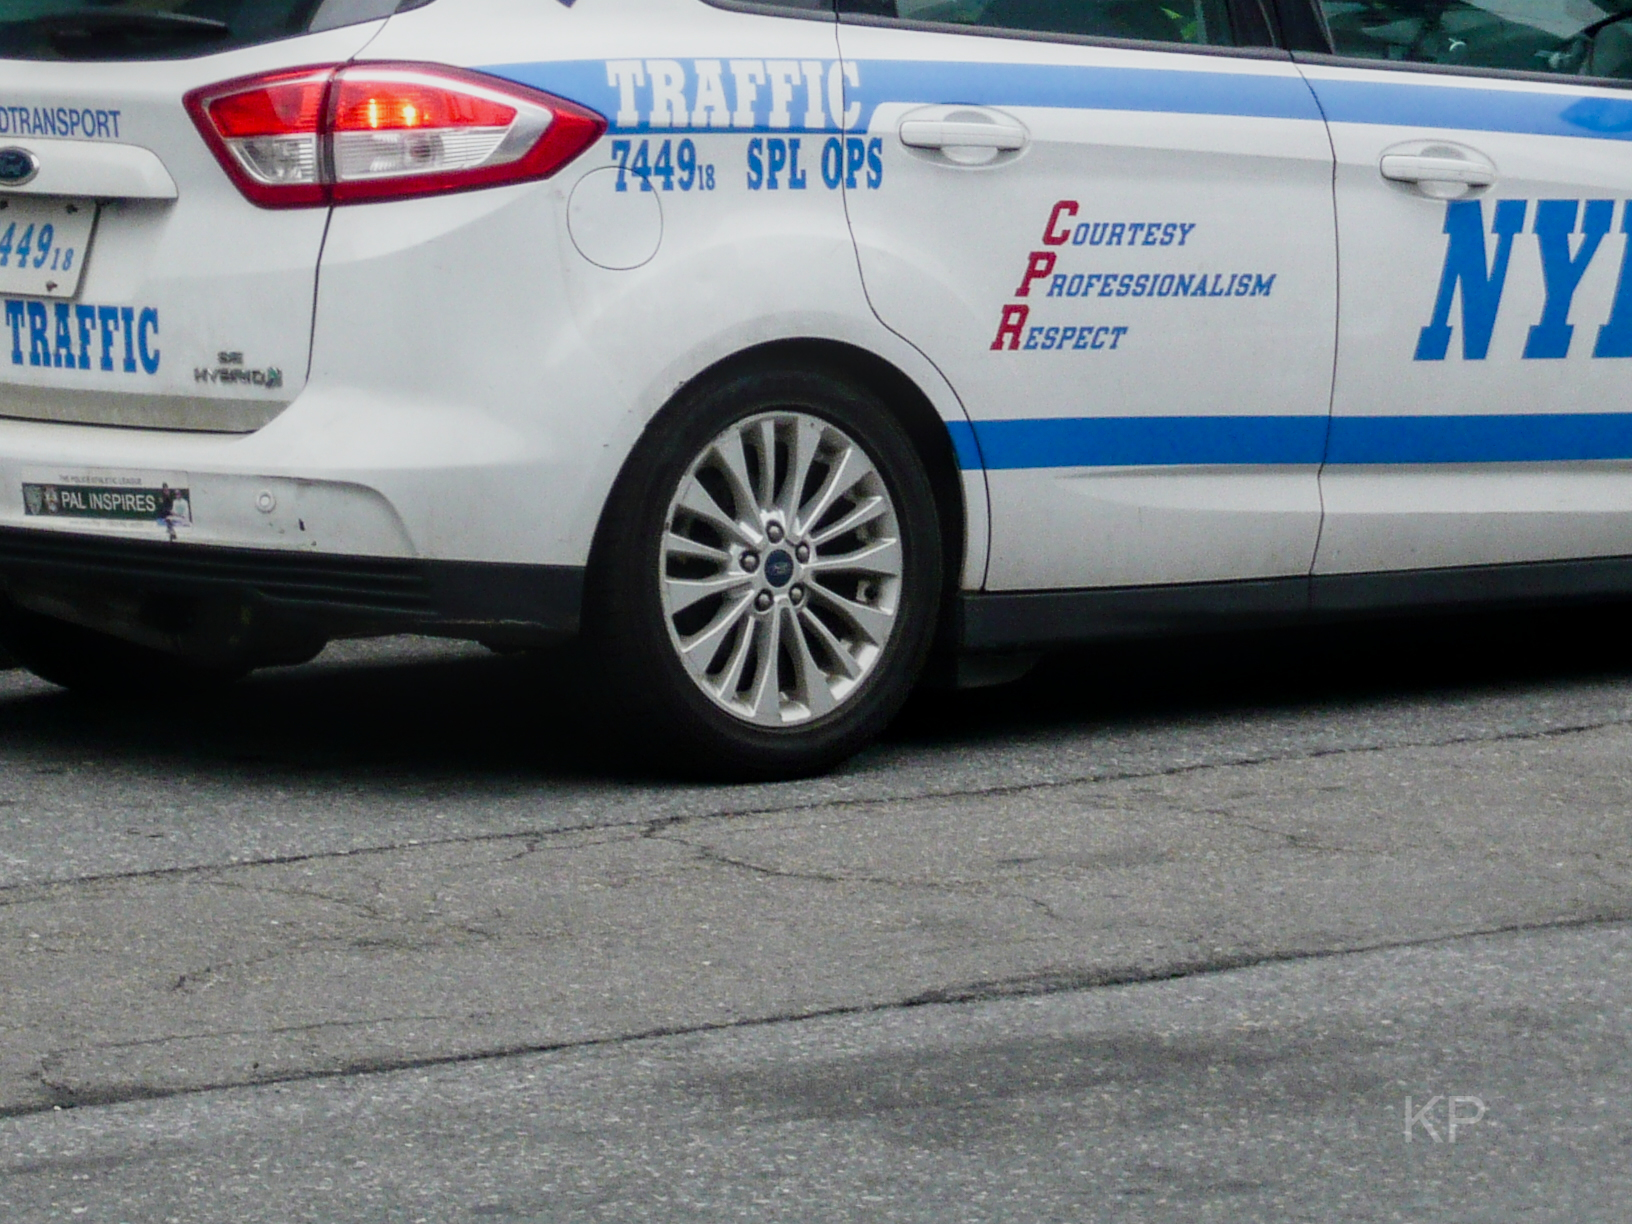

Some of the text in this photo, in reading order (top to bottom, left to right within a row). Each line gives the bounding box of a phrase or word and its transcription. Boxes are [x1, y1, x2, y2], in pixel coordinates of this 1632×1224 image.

[605, 60, 862, 130] TRAFFIC
[746, 137, 807, 191] SPL
[821, 137, 884, 191] OPS
[4, 299, 161, 376] TRAFFIC
[60, 491, 157, 512] PAL INSPIRES
